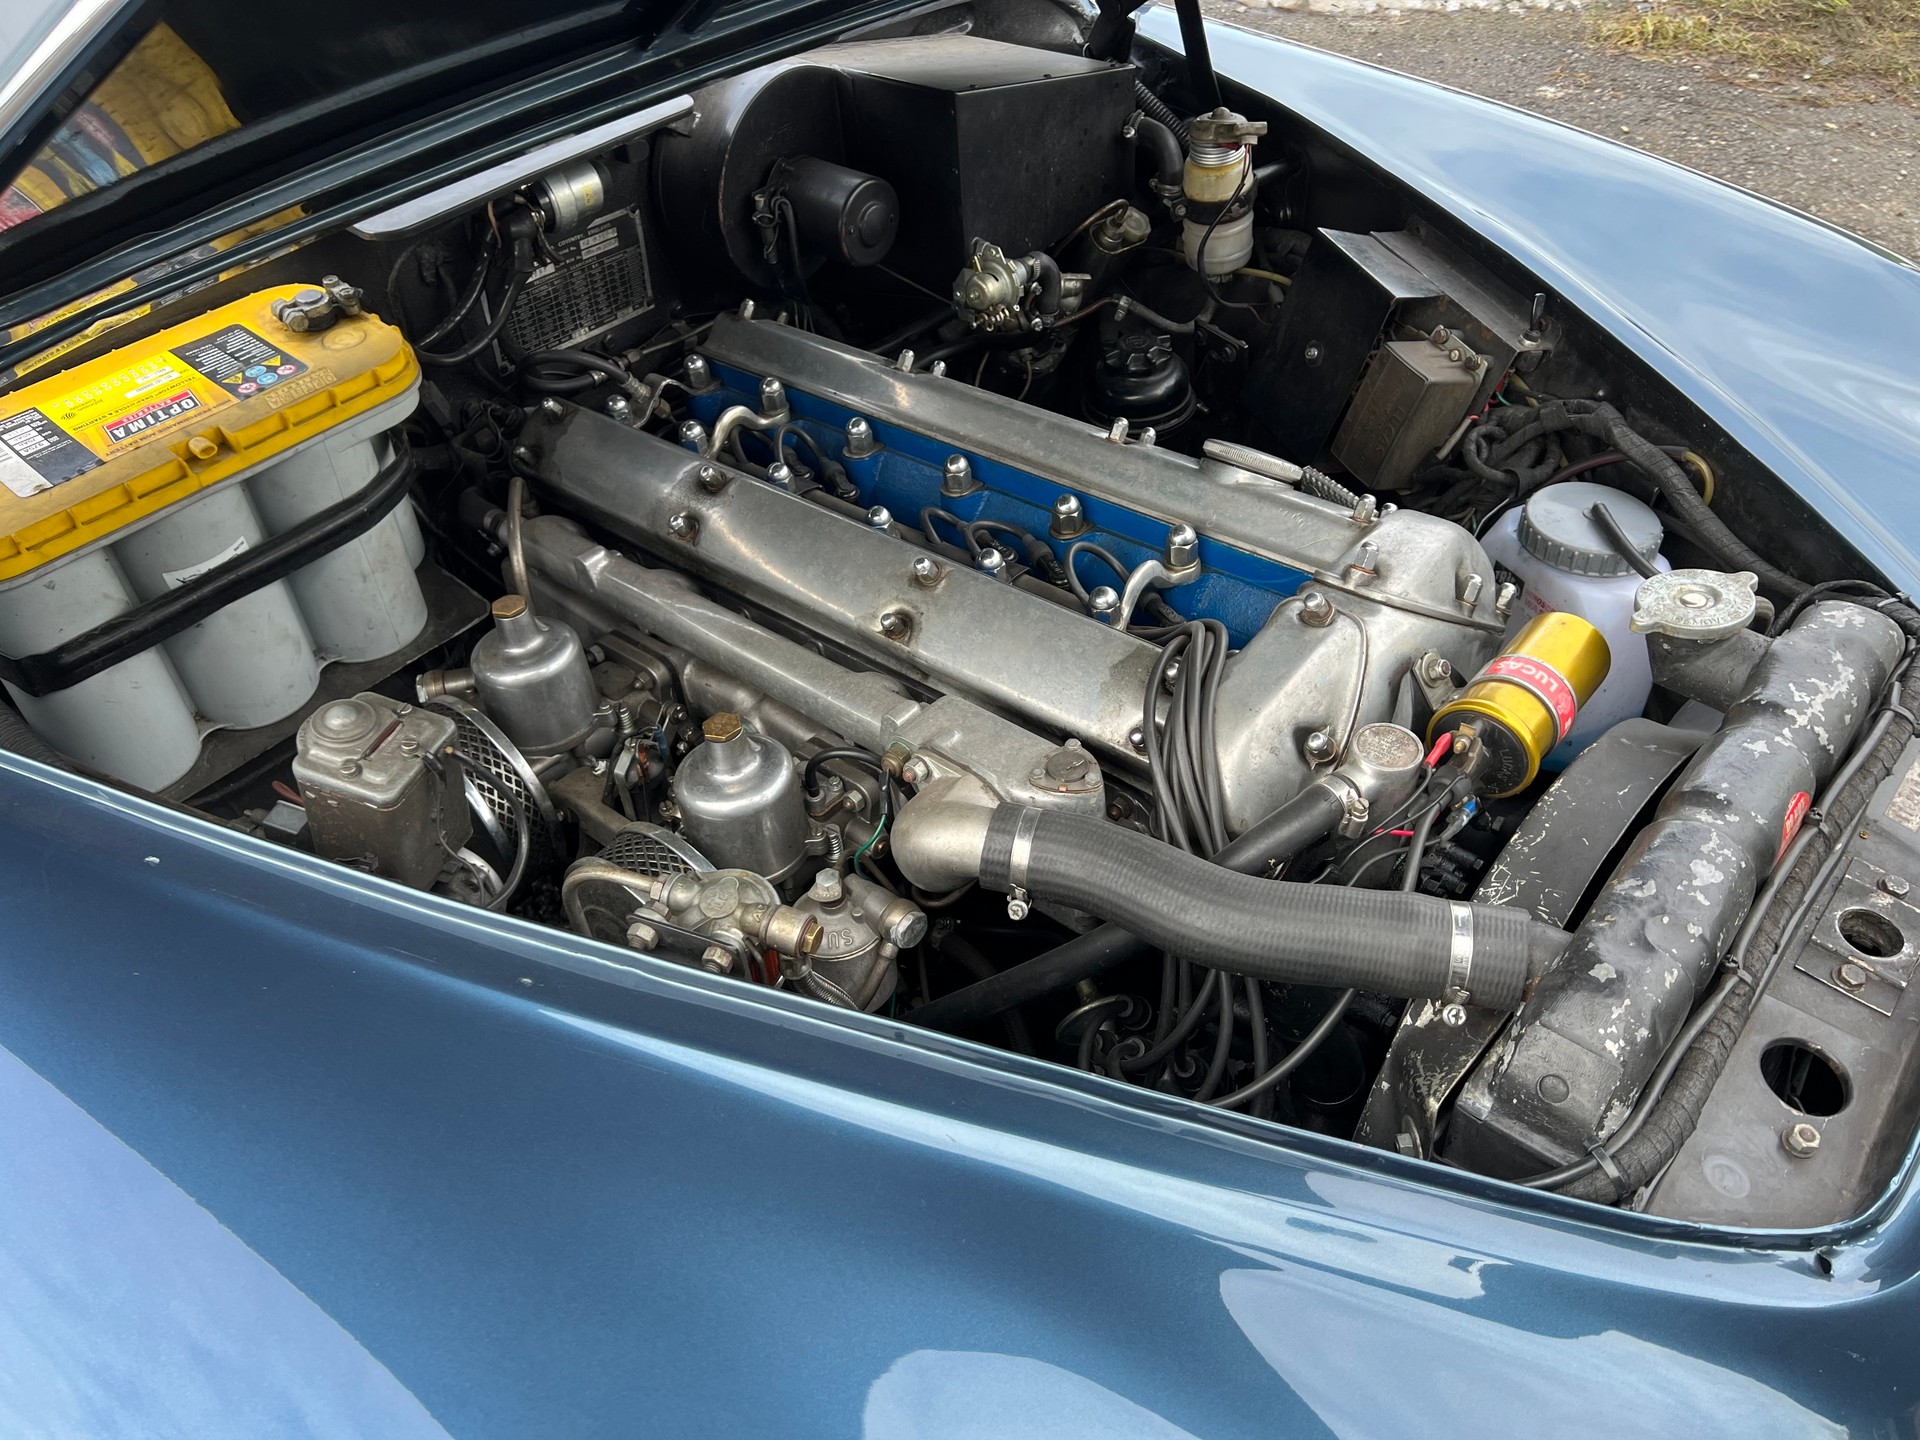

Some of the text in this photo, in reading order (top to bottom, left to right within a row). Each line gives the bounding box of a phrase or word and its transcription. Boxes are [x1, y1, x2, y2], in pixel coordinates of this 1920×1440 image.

[111, 397, 195, 438] OPTIMA
[121, 399, 172, 422] BATTERIES
[1497, 660, 1559, 692] LUCAS
[1498, 748, 1513, 783] LUCAS
[828, 929, 853, 948] SU
